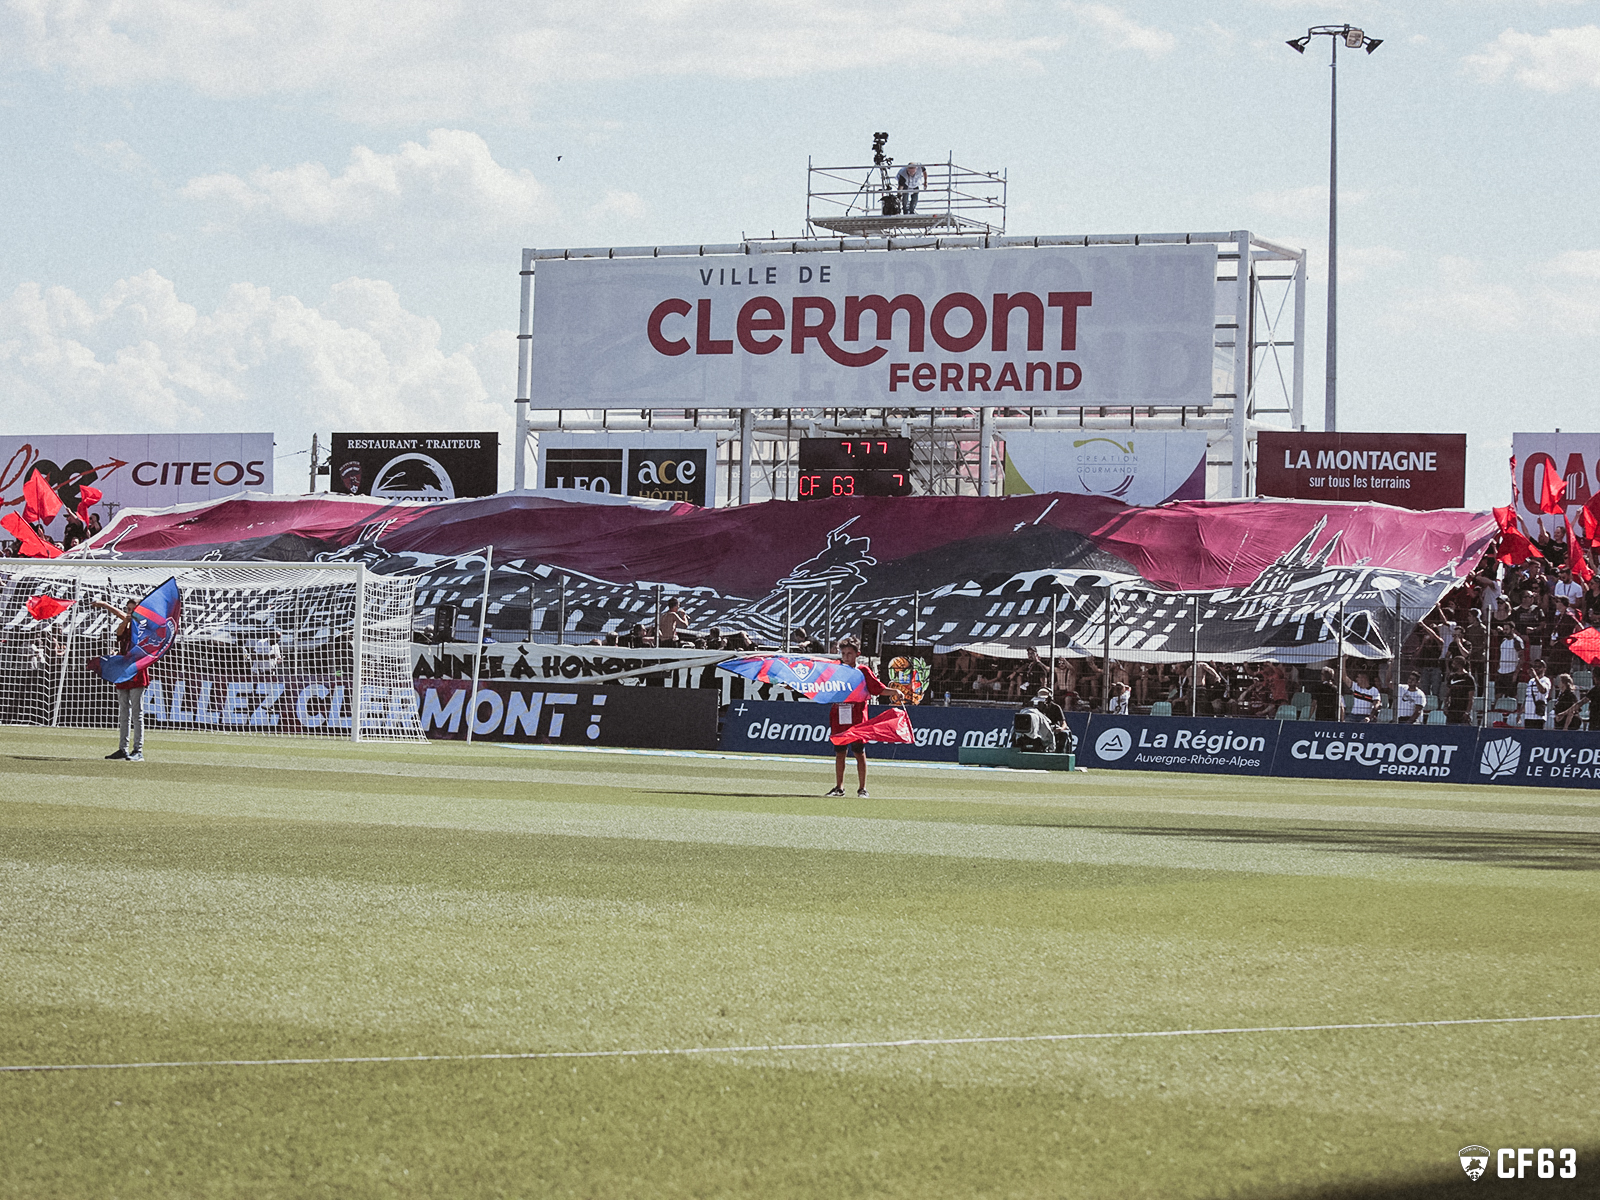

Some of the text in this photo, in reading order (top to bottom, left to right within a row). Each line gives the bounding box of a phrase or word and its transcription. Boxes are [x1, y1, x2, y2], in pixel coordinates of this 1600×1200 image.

[699, 265, 831, 286] VILLE DE
[347, 439, 418, 449] RESTAURANT
[426, 439, 481, 449] TRAITEUR
[1076, 455, 1138, 463] CREATION
[1284, 450, 1437, 472] LA MONTAGNE
[131, 461, 265, 486] CITEOS
[637, 460, 697, 485] ace
[1076, 466, 1138, 474] GOURMANDE
[799, 475, 822, 496] CF
[832, 475, 855, 496] 63
[1309, 475, 1411, 489] sur tous les terrains
[511, 645, 536, 679] À
[143, 680, 284, 727] ALLEZ
[1138, 728, 1265, 754] La Région
[1314, 731, 1365, 740] VILLE DE
[1135, 752, 1260, 768] Auvergne-Rhône-Alpes
[1526, 765, 1543, 777] LE
